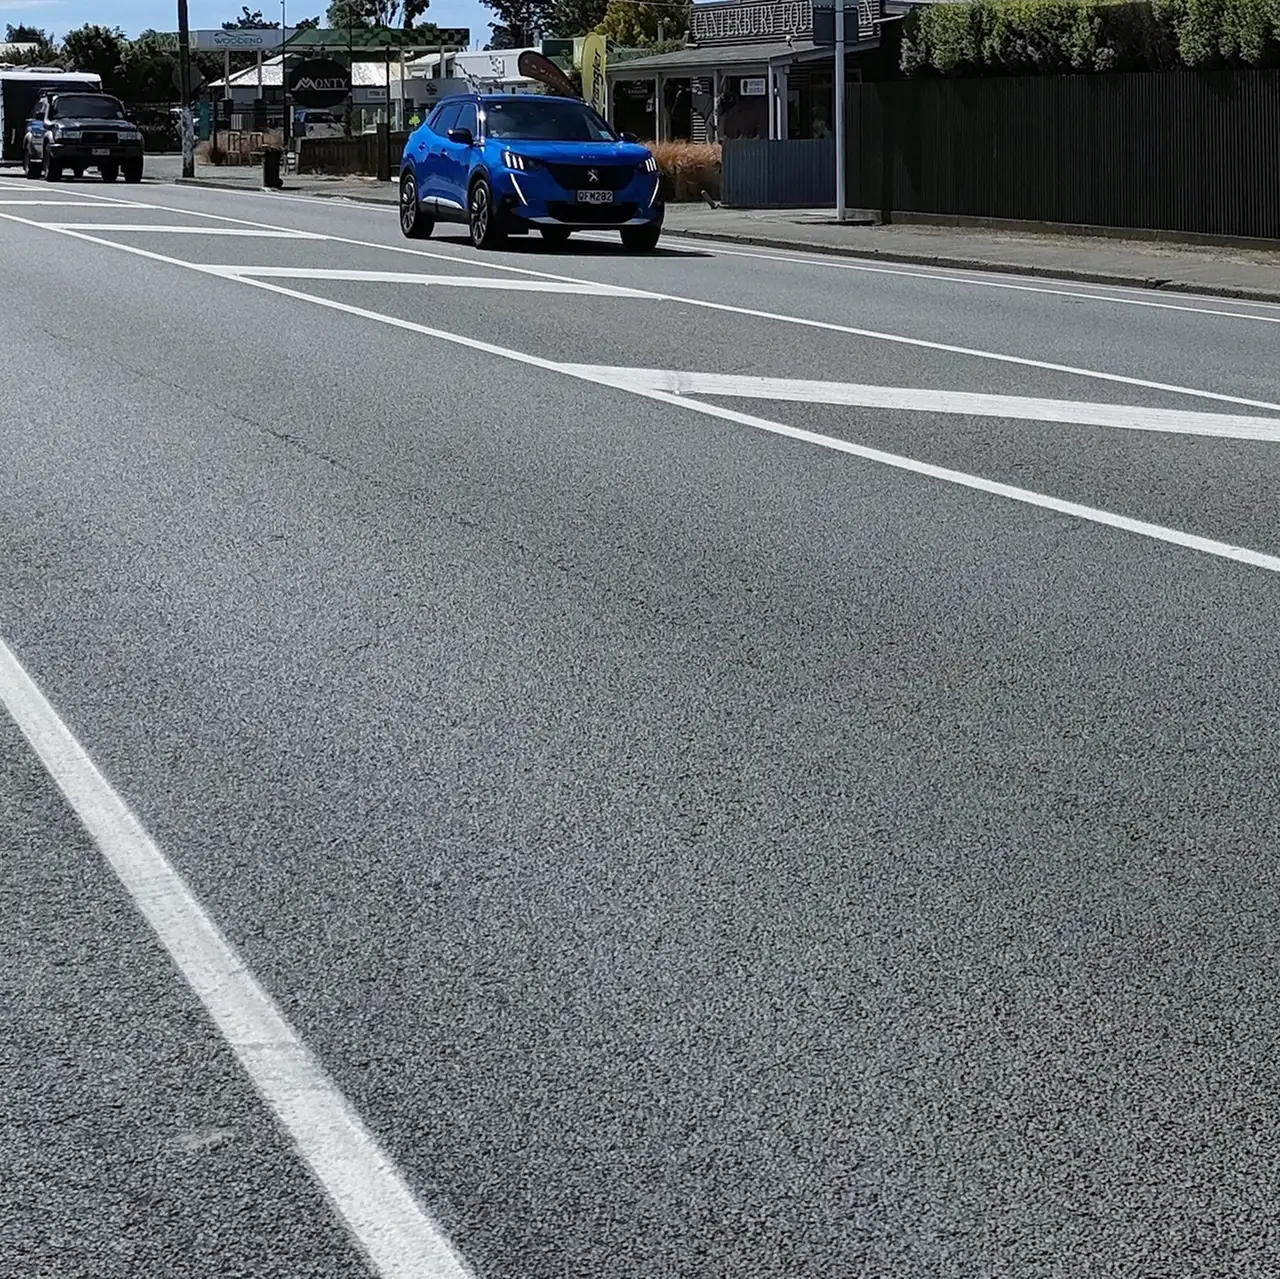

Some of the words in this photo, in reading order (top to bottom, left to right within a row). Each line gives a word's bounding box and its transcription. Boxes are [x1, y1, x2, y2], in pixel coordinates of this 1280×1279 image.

[694, 5, 776, 40] CANTERBURY
[214, 37, 263, 45] WOODEND
[293, 77, 348, 90] MONTY
[592, 48, 604, 110] rangler
